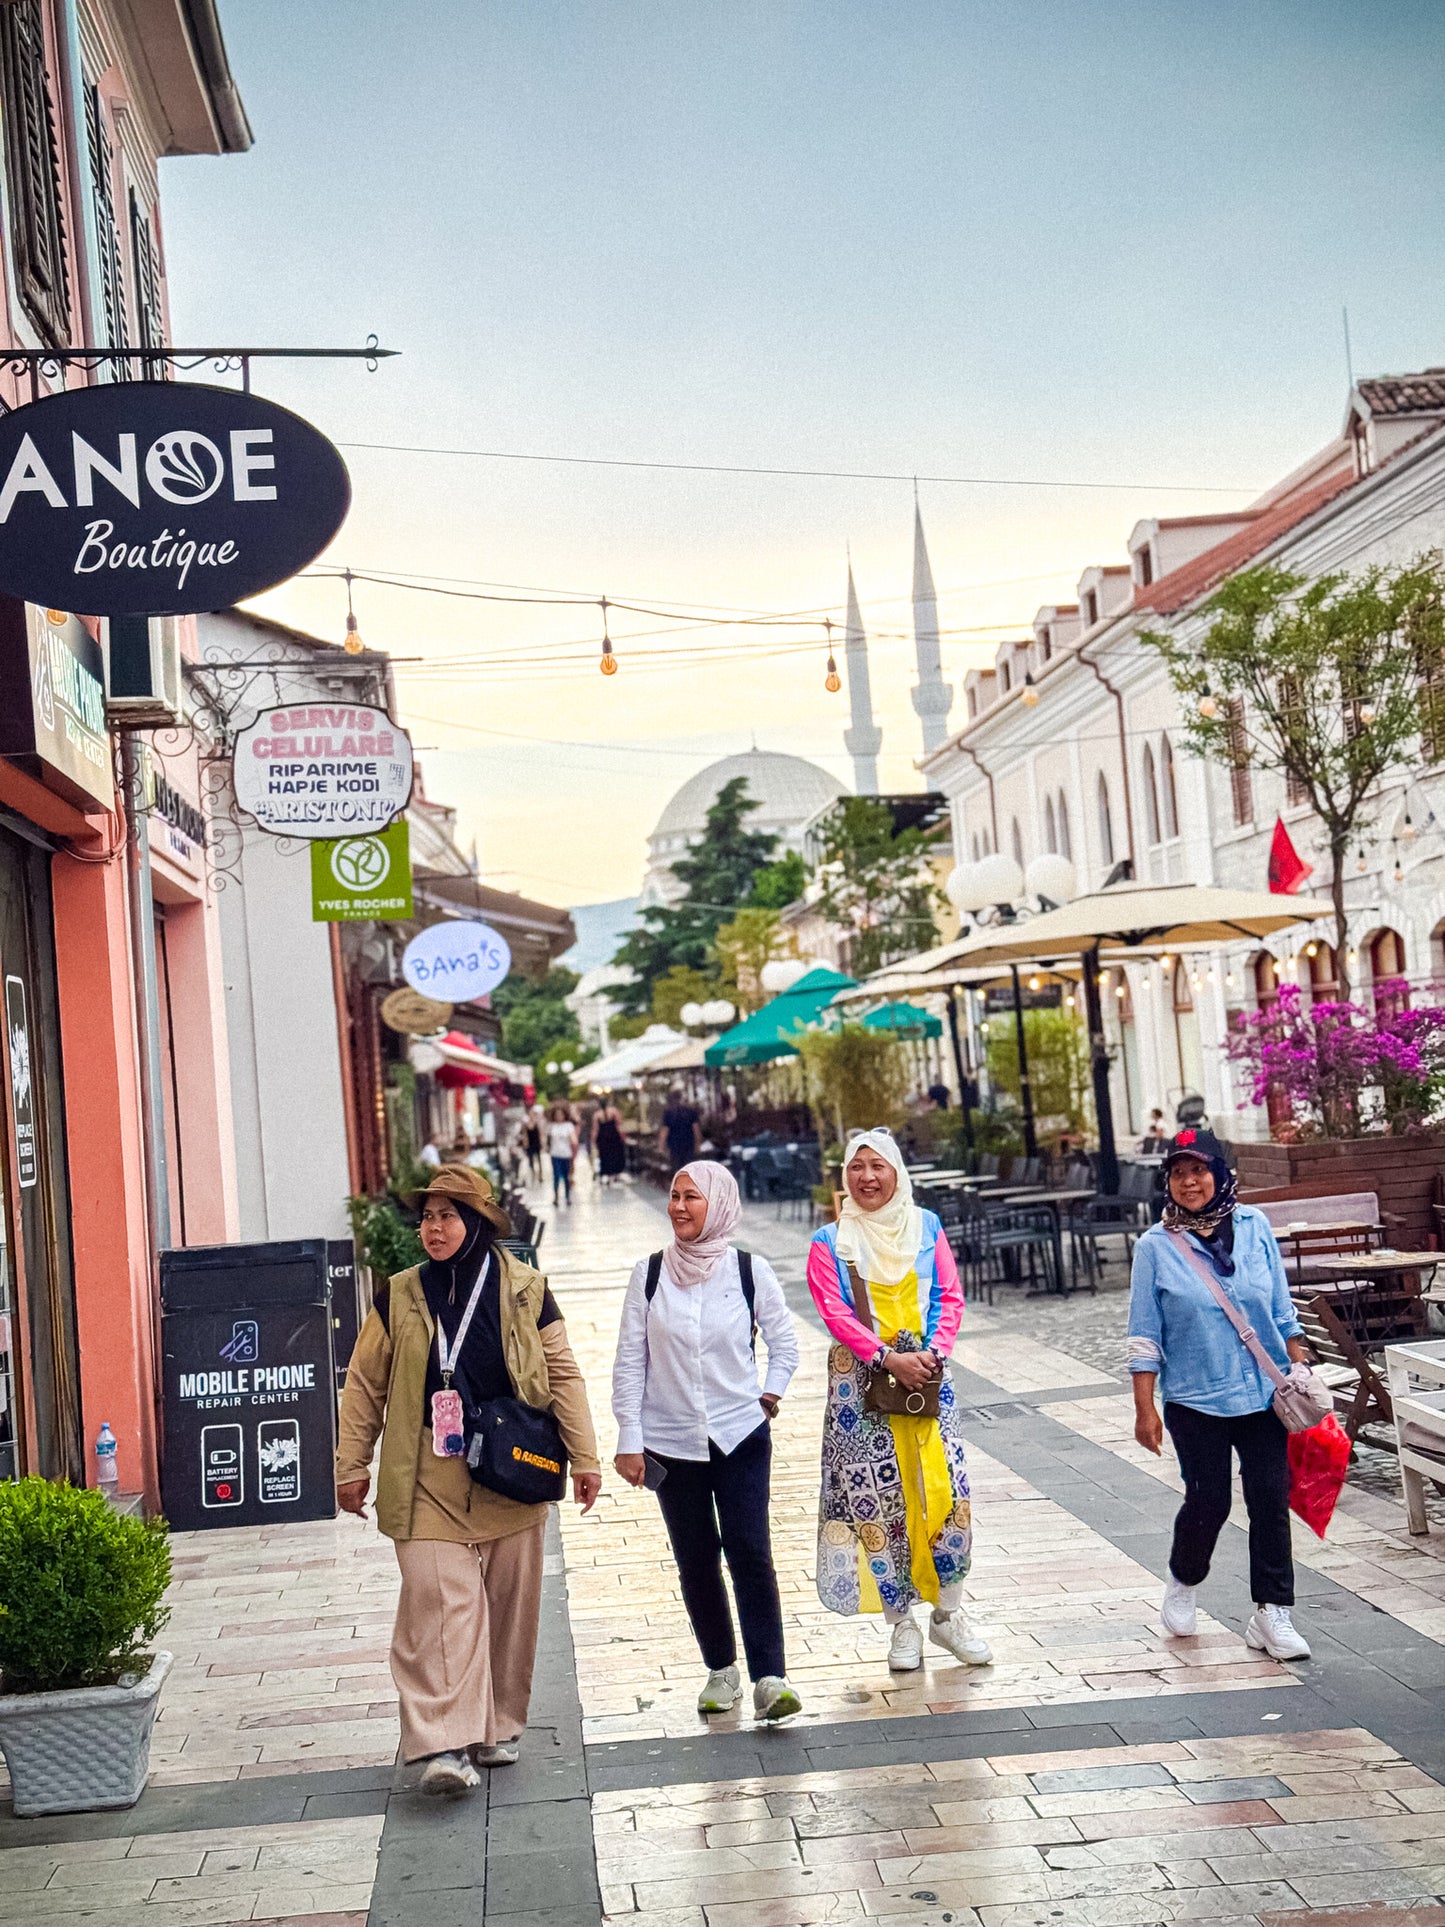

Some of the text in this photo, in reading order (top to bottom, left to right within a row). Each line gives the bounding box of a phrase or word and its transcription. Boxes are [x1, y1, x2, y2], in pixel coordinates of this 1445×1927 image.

[74, 519, 239, 590] Boutique
[270, 708, 375, 733] SERVIS
[269, 762, 377, 777] RIPARIME
[268, 779, 379, 794] HAPJE KODI
[319, 898, 406, 910] YVES ROCHER
[180, 1364, 315, 1397] MOBILE PHONE
[197, 1392, 299, 1409] REPAIR CENTER
[207, 1467, 238, 1475] BATTERY
[263, 1475, 295, 1484] REPLACE
[266, 1483, 294, 1491] SCREEN
